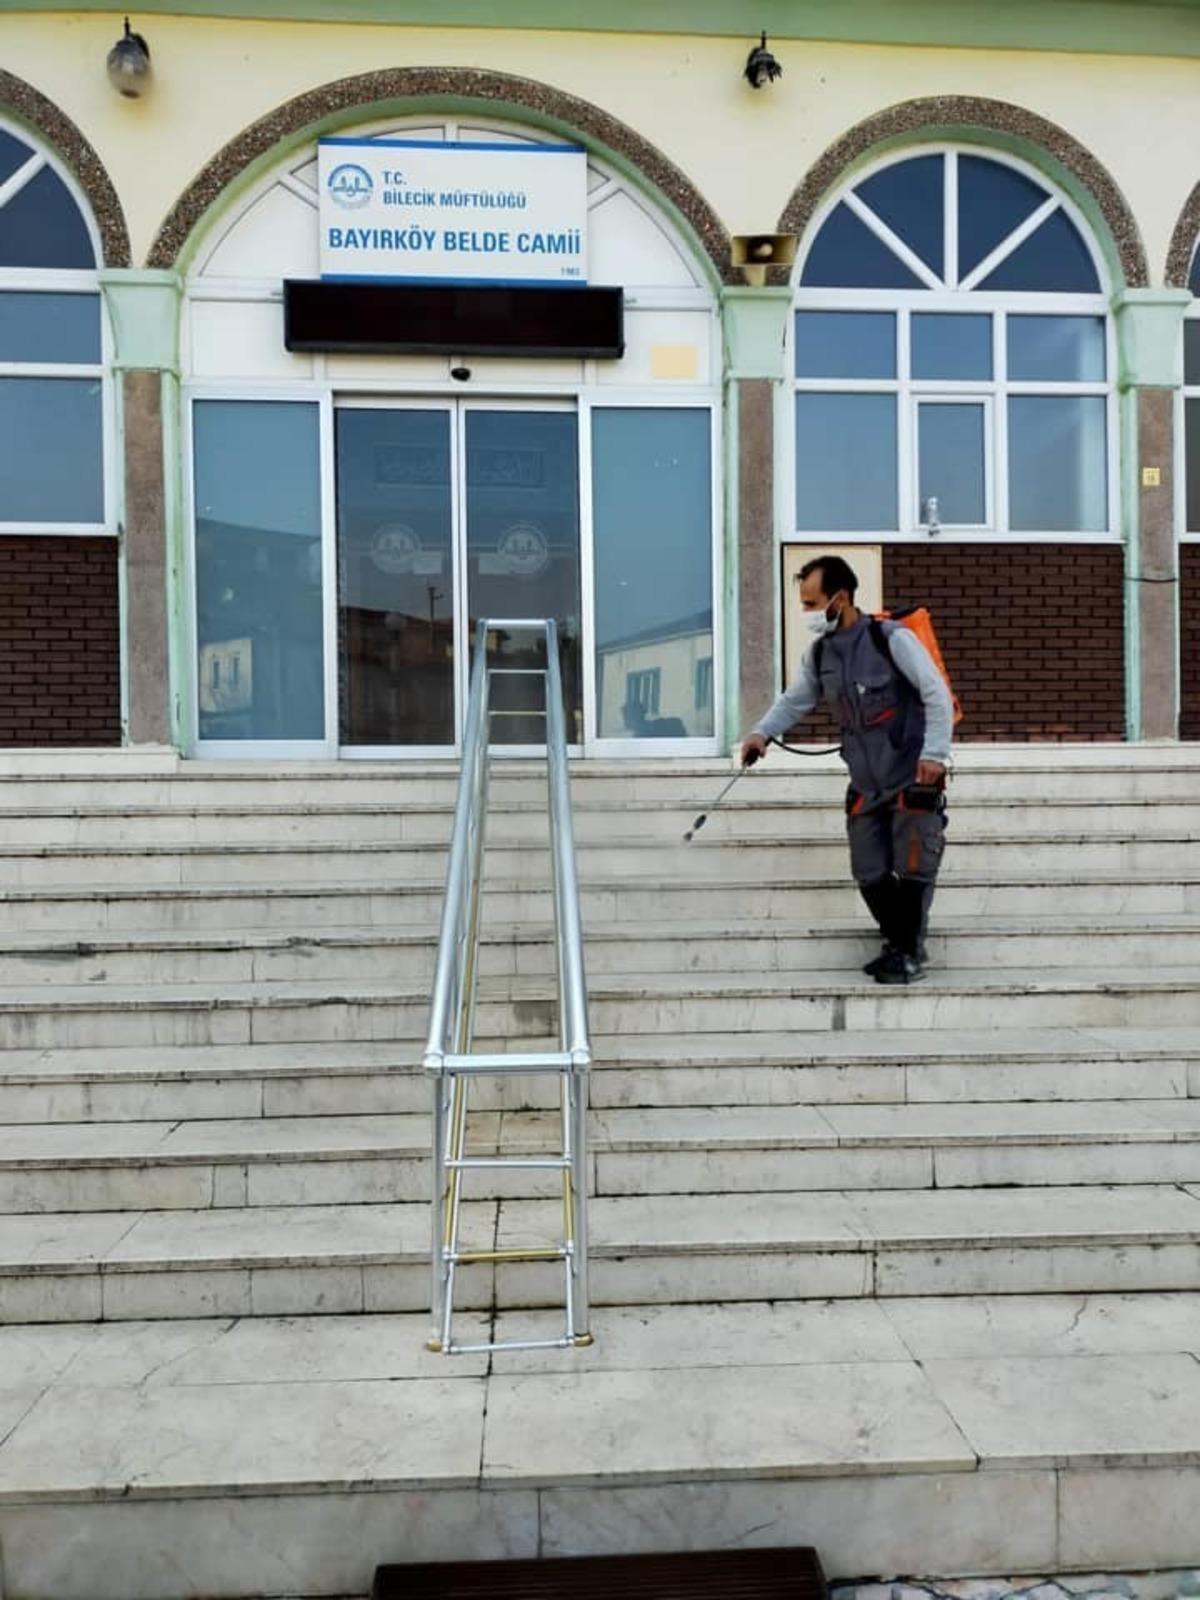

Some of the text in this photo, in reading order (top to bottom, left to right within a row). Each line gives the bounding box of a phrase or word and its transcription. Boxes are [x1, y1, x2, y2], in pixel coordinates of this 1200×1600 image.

[382, 171, 407, 186] T.C.
[383, 188, 526, 209] BİLECİK MÜFTÜLÜĞÜ
[329, 224, 581, 254] BAYIRKÖY BELDE CAMİİ
